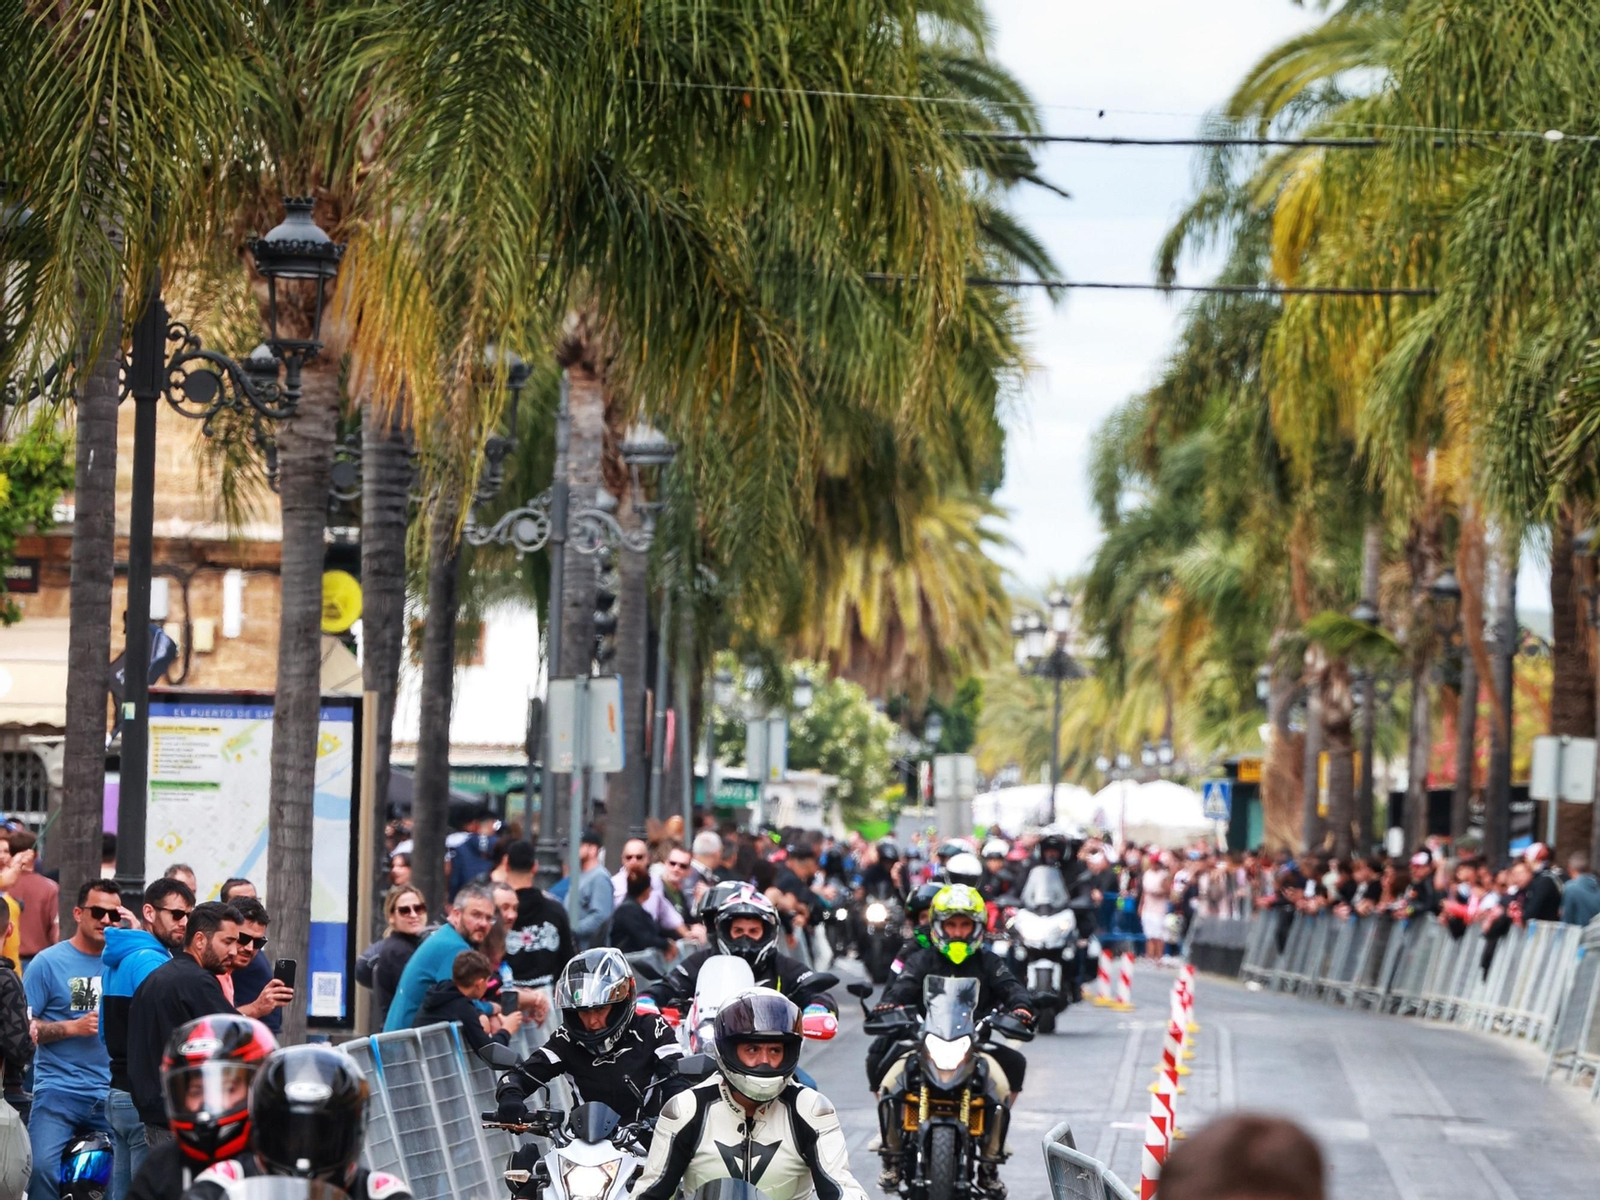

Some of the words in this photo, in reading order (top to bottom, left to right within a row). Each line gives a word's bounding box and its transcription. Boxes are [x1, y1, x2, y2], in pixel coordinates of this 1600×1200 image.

[174, 708, 186, 717] EL
[190, 708, 233, 717] PUERTO
[237, 709, 252, 718] DE
